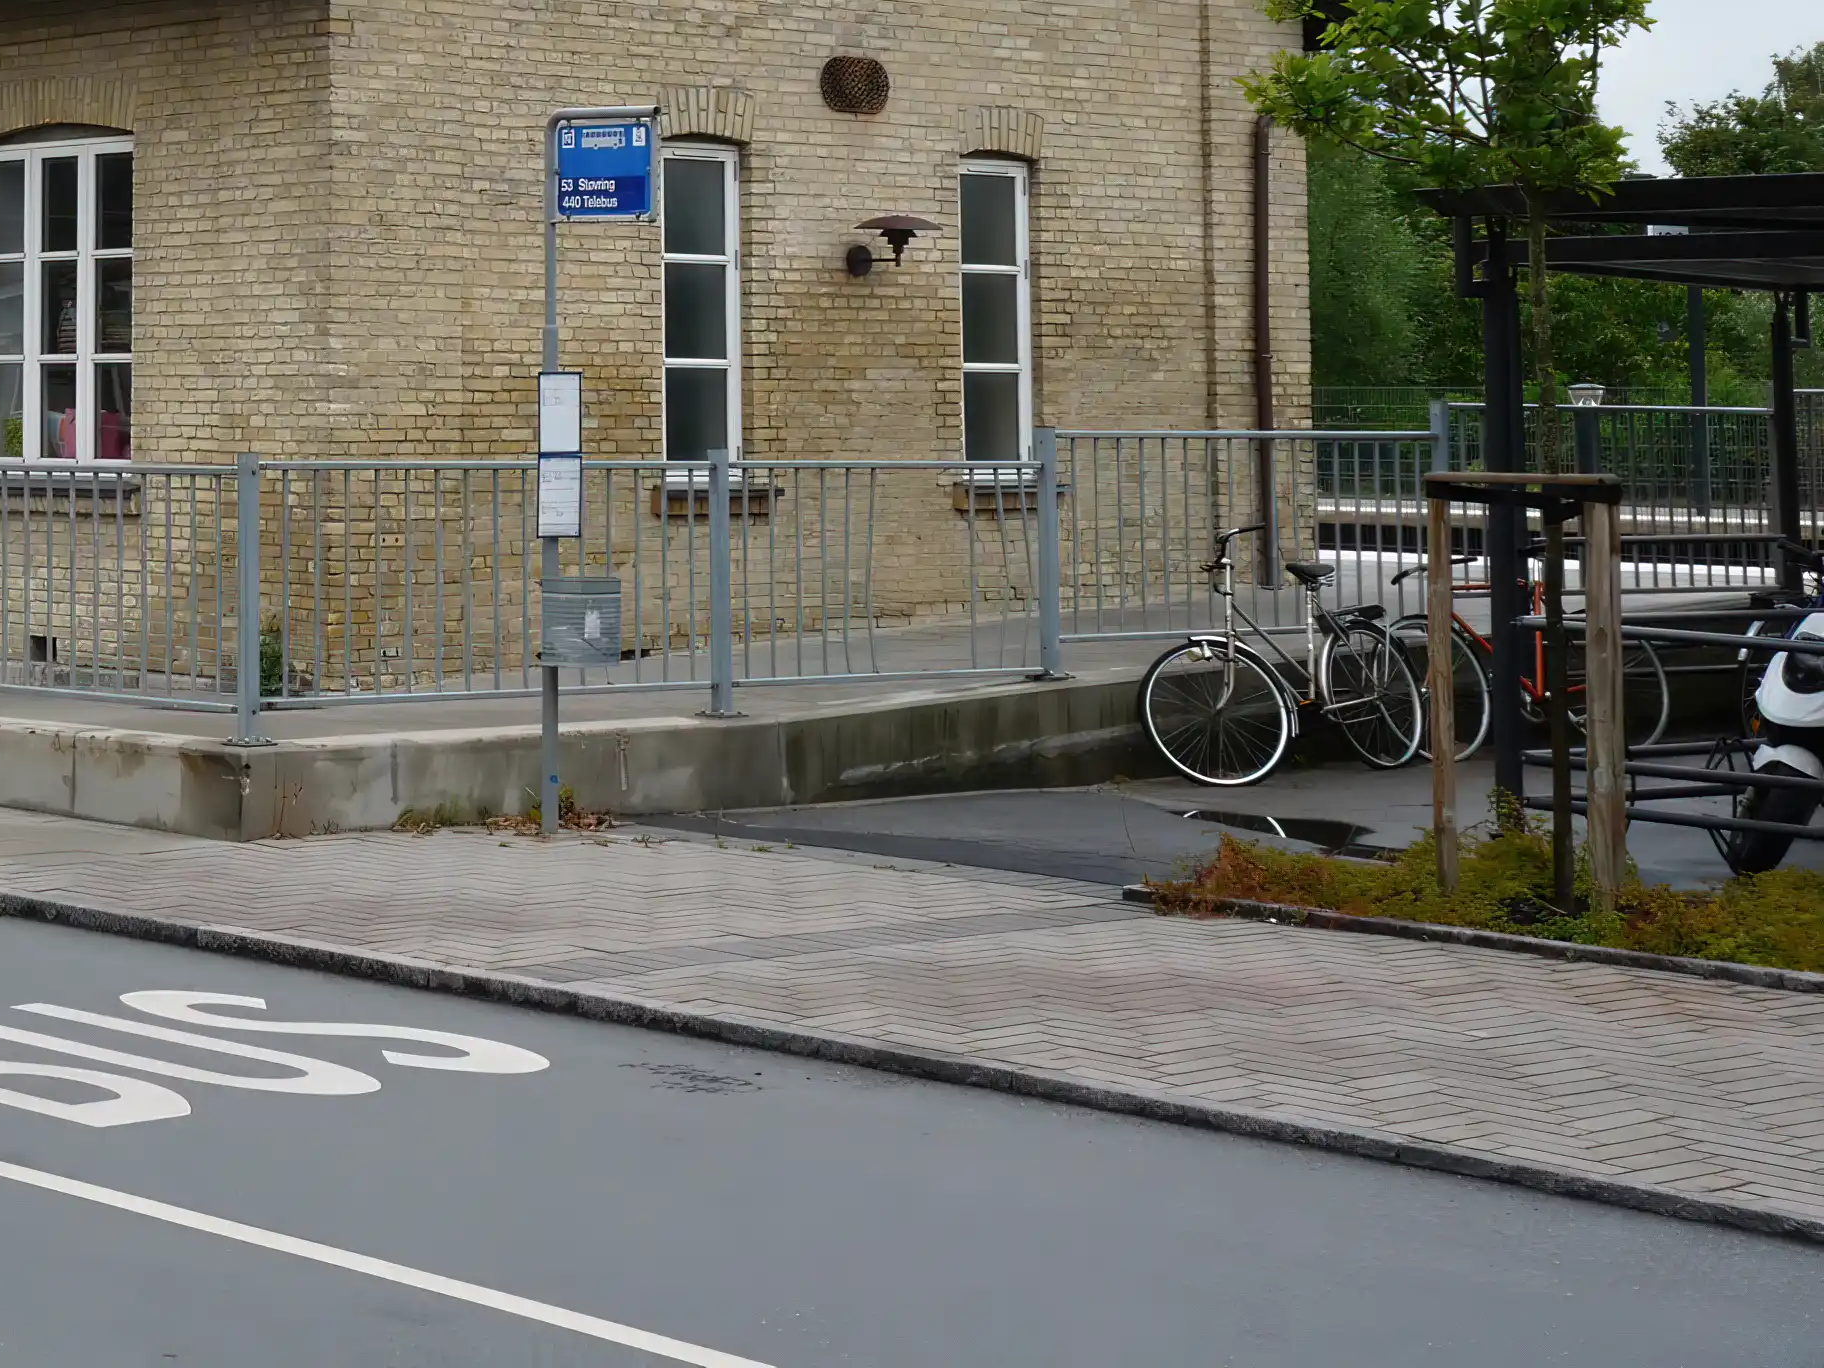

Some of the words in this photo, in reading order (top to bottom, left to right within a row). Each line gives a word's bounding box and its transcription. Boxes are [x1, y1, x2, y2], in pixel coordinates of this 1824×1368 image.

[561, 179, 573, 191] 53
[578, 177, 616, 192] Støvring
[562, 196, 581, 208] 440
[583, 195, 618, 208] Telebus
